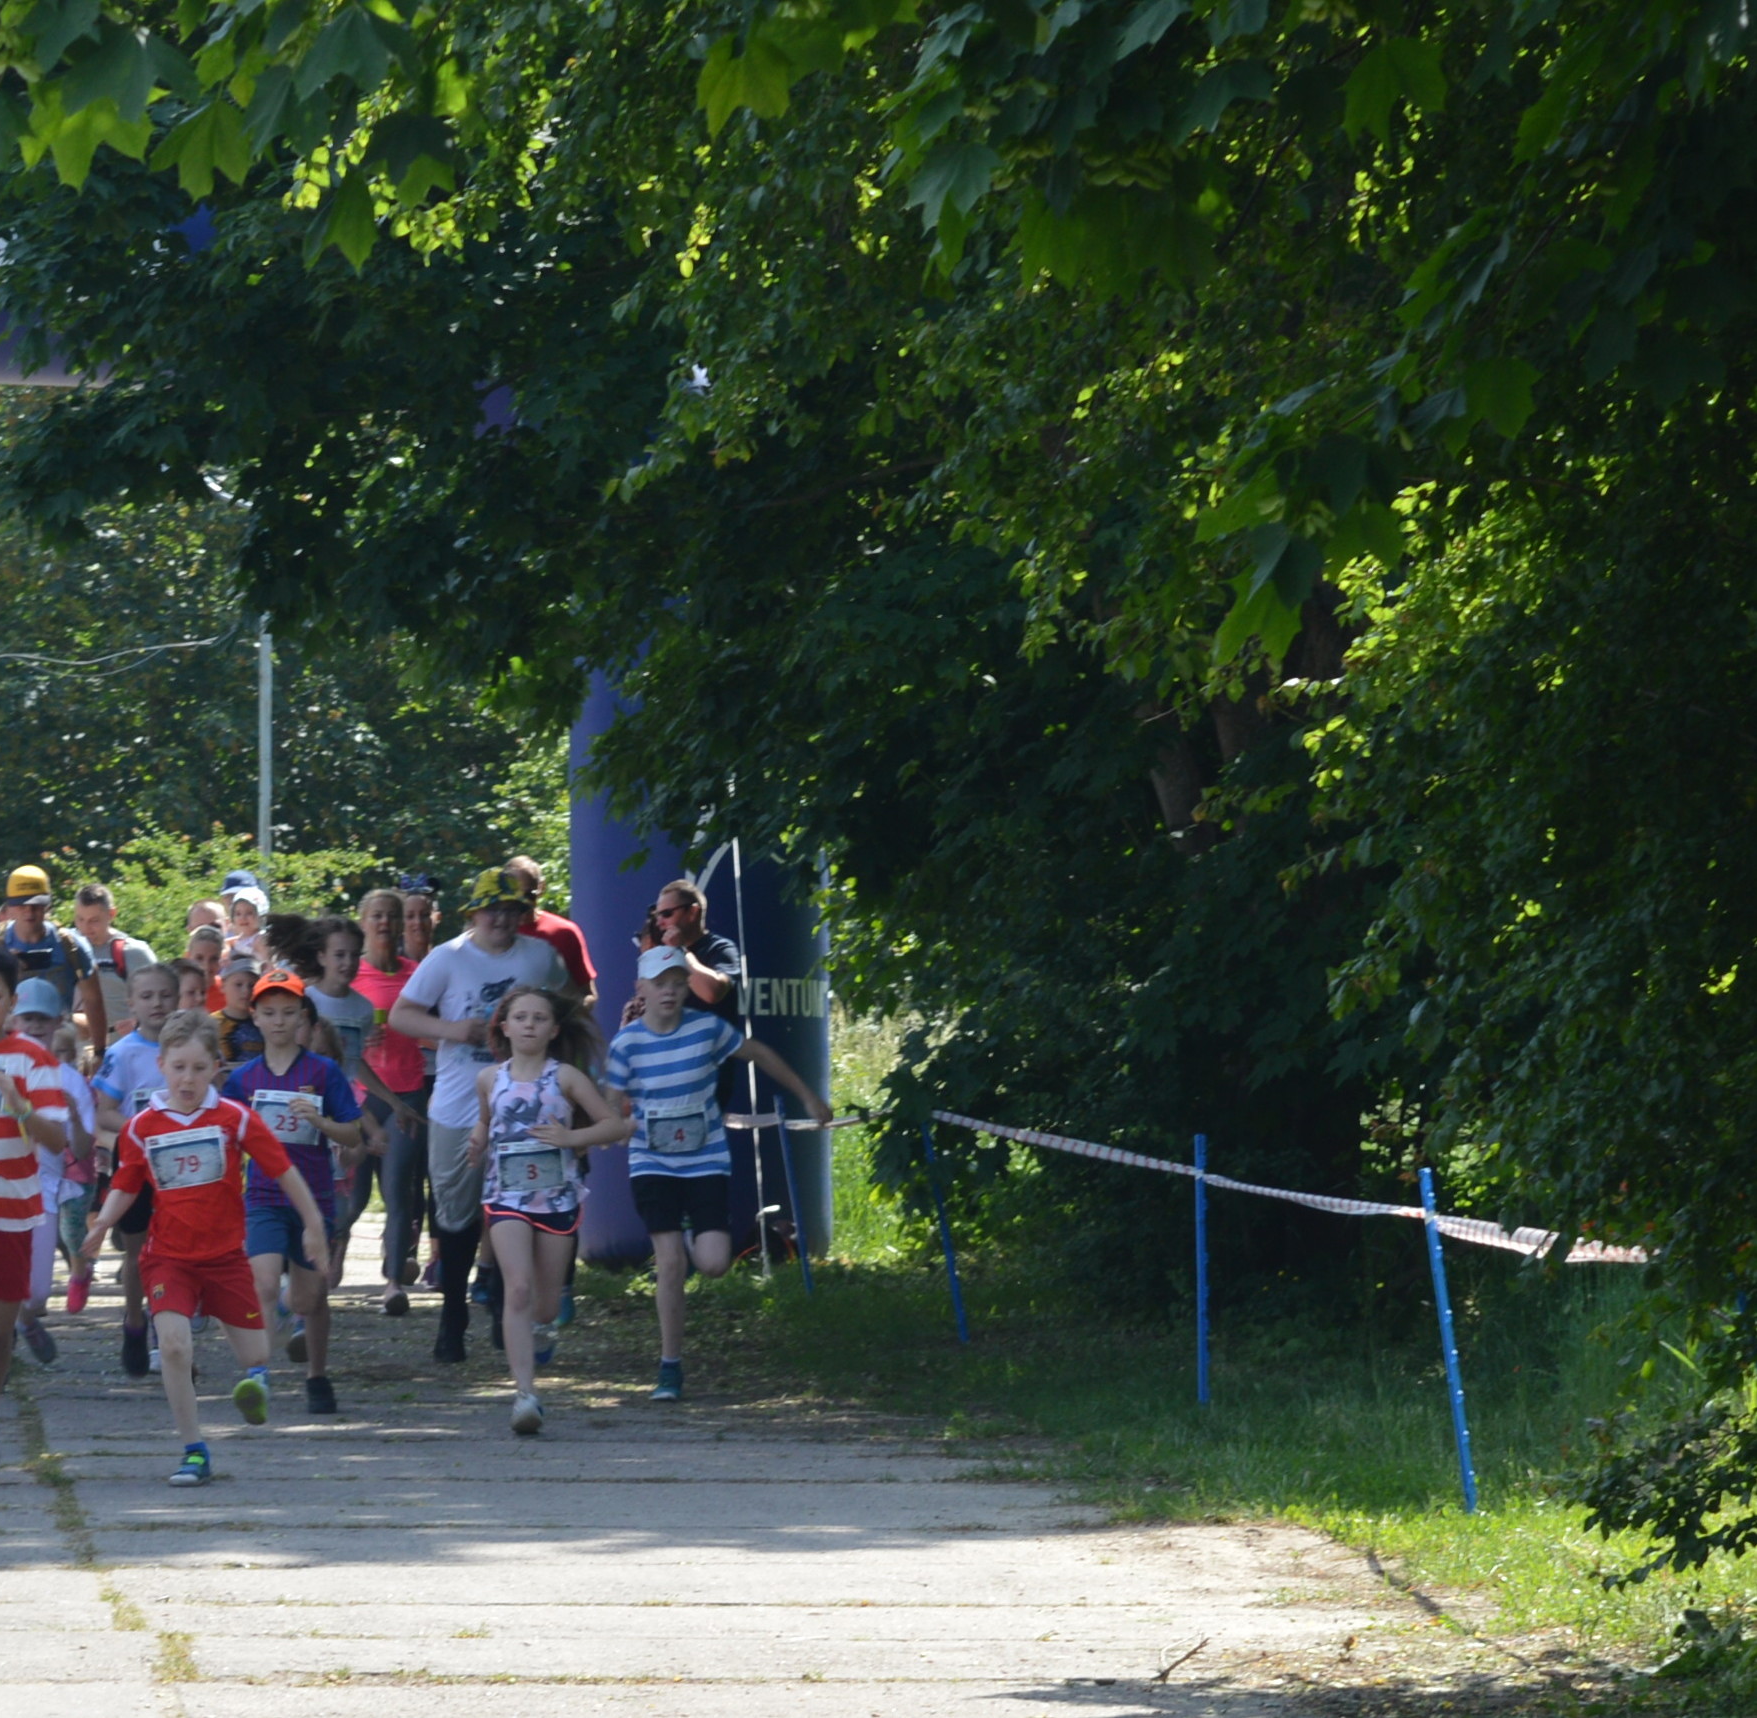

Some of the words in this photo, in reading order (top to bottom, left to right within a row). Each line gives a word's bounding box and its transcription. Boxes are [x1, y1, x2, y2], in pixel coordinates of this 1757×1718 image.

[275, 1114, 299, 1132] 23
[673, 1127, 685, 1143] 4
[174, 1154, 202, 1175] 79
[526, 1163, 538, 1180] 3
